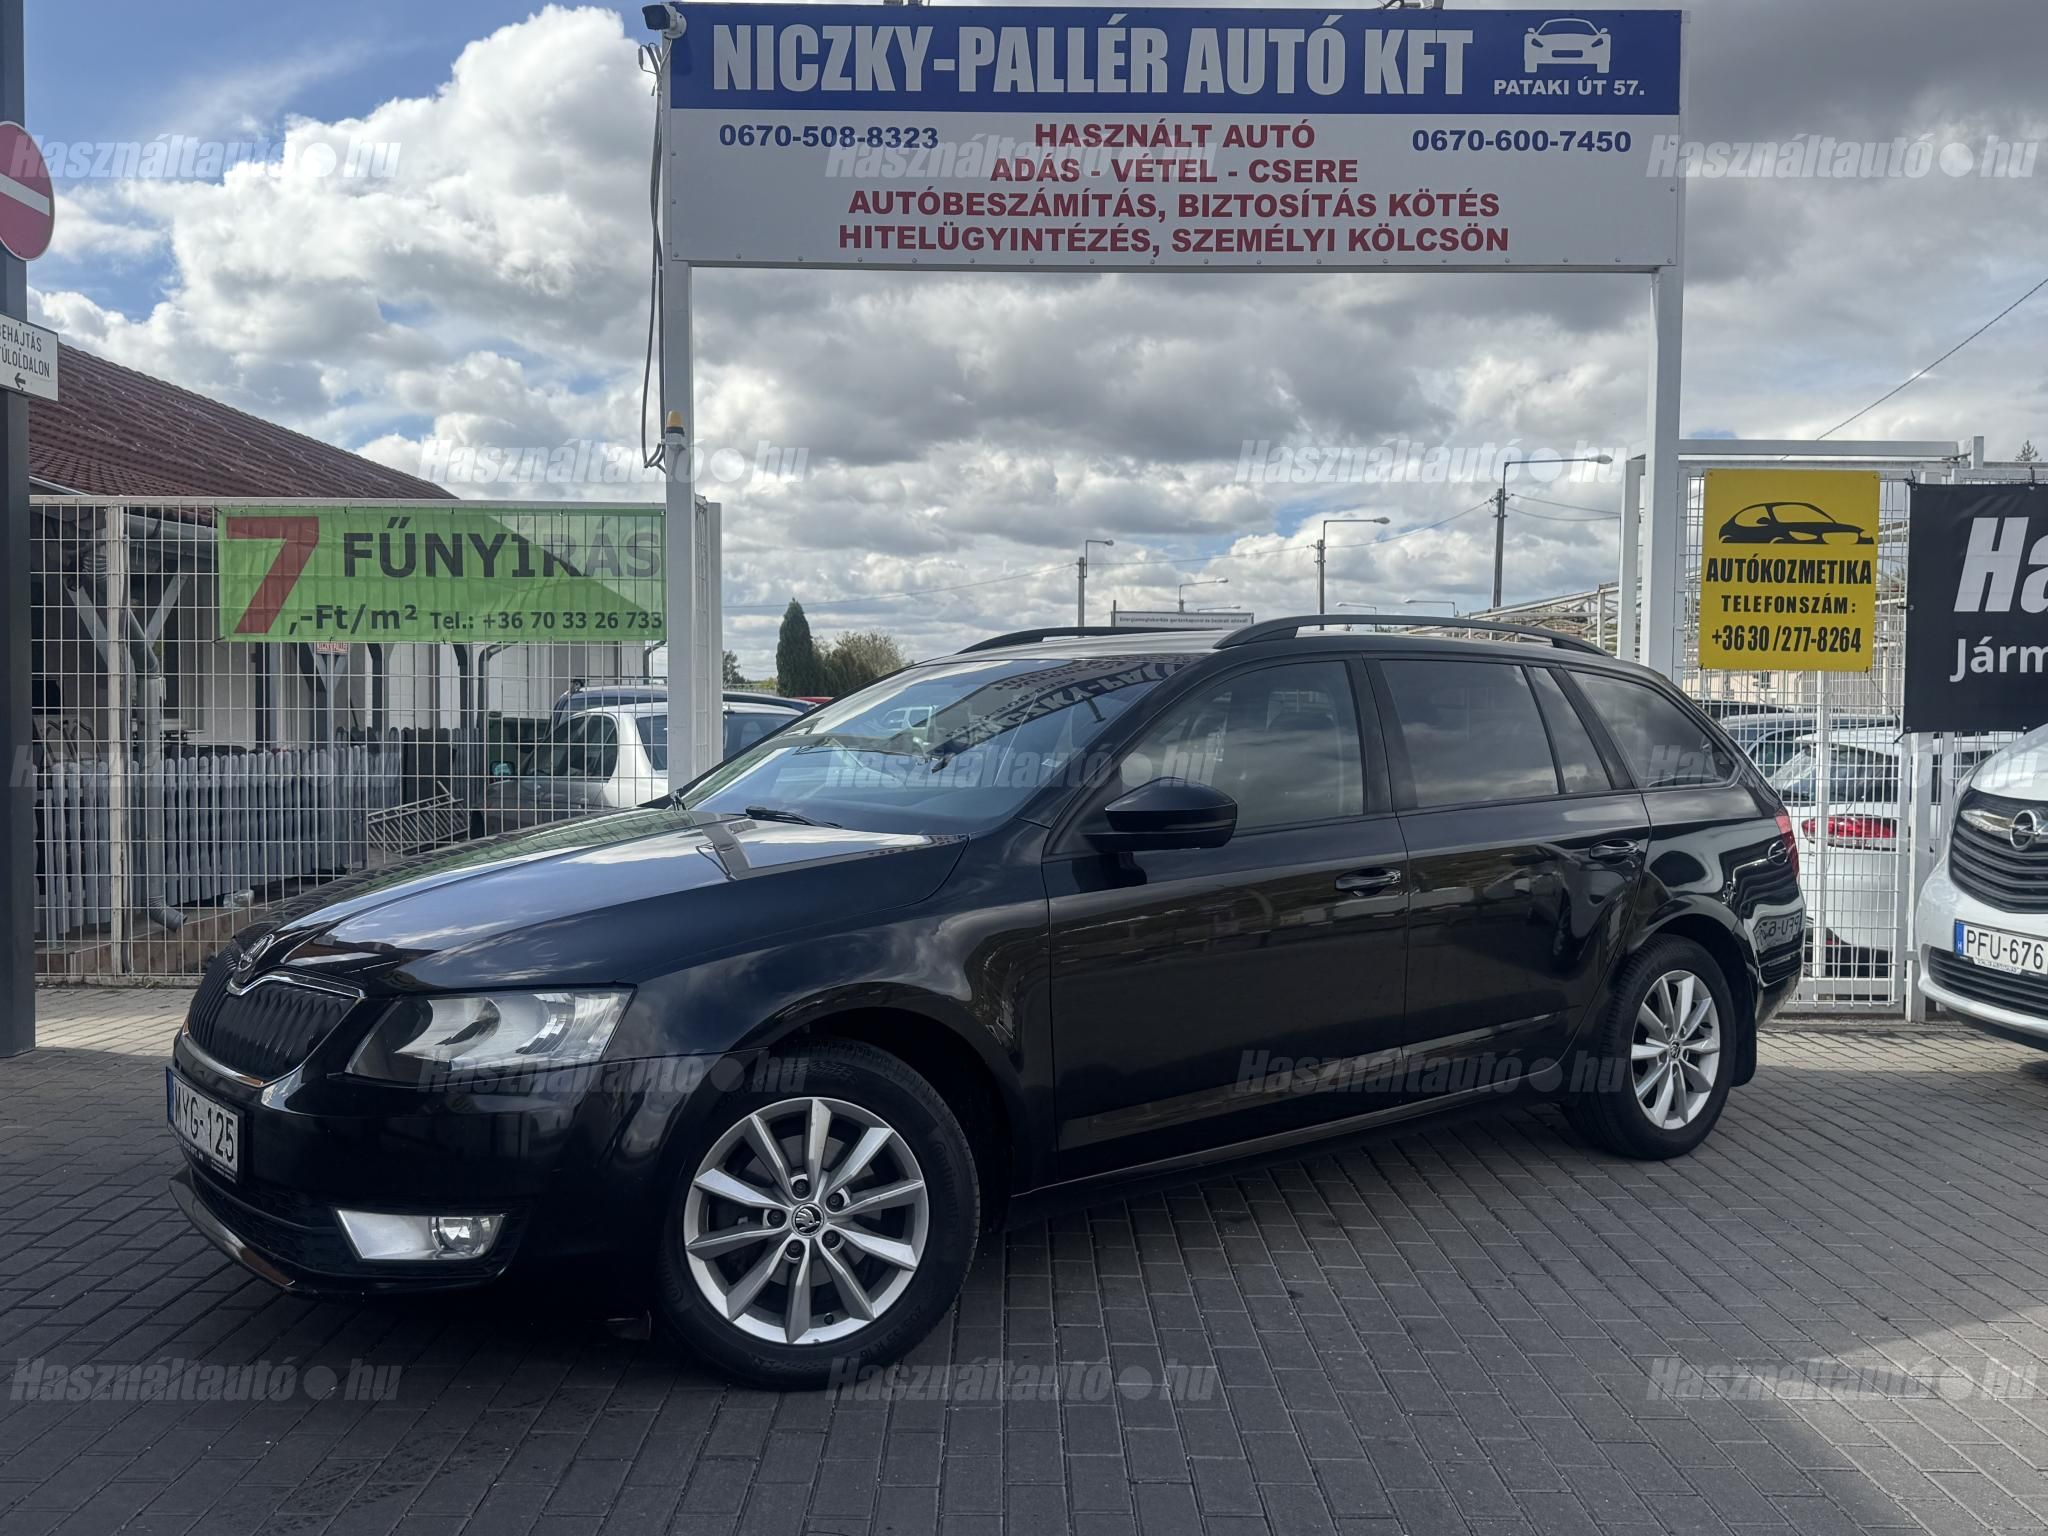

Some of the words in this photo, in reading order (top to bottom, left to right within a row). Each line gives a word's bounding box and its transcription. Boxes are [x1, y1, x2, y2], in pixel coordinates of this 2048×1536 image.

[712, 14, 1168, 94] NICZKY-PALLÉR
[1183, 14, 1346, 96] AUTÓ
[1363, 29, 1473, 96] KFT
[1493, 79, 1570, 96] PATAKI
[1577, 75, 1606, 96] ÚT
[1613, 79, 1645, 96] 57.
[718, 124, 939, 149] 0670-508-8323
[1034, 118, 1213, 148] HASZNÁLT
[1222, 118, 1316, 148] AUTÓ
[1411, 129, 1632, 153] 0670-600-7450
[990, 152, 1081, 183] ADÁS
[1111, 152, 1218, 183] VÉTEL
[1249, 158, 1359, 184] CSERE
[848, 185, 1166, 222] AUTÓBESZÁMÍTÁS,
[1177, 188, 1377, 219] BIZTOSÍTÁS
[1388, 188, 1500, 218] KÖTÉS
[839, 221, 1161, 258] HITELÜGYINTÉZÉS,
[1171, 223, 1336, 253] SZEMÉLYI
[1348, 225, 1509, 252] KÖLCSÖN
[226, 515, 319, 634] 7
[1705, 553, 1872, 585] AUTÓKOZMETIKA
[483, 611, 523, 630] +36
[530, 611, 556, 630] 70
[562, 611, 587, 630] 33
[595, 611, 619, 630] 26
[1949, 636, 2048, 683] Járm
[1966, 928, 2044, 970] PFU-676
